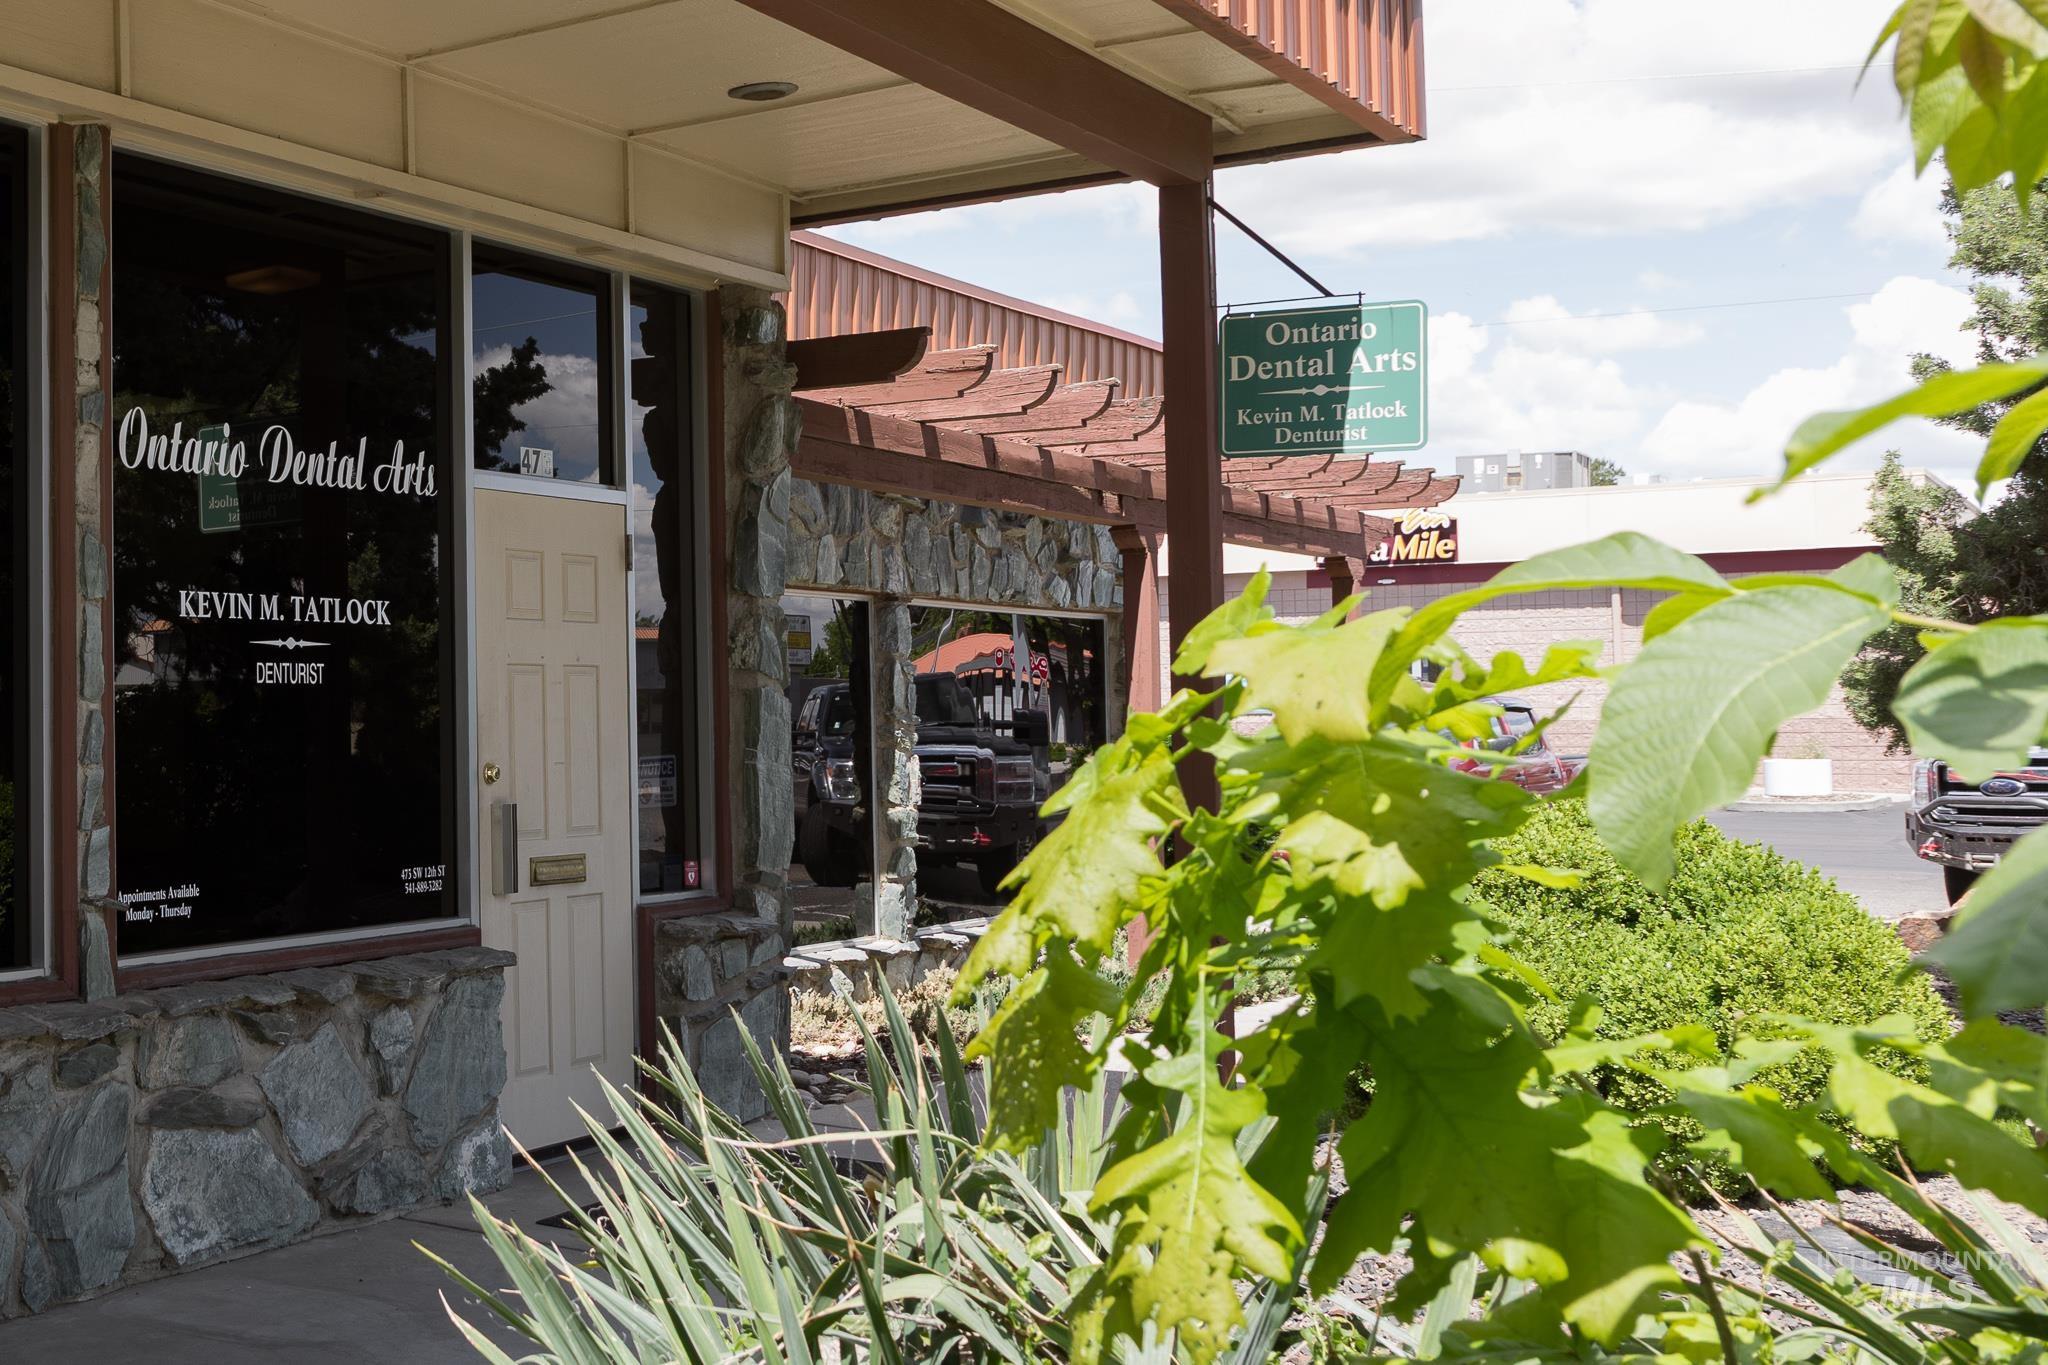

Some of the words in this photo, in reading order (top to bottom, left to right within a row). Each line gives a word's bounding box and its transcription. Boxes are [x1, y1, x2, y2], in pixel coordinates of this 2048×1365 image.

[1265, 316, 1377, 346] Ontario
[1229, 348, 1336, 382] Dental
[1346, 347, 1417, 374] Arts
[1237, 407, 1293, 426] Kevin
[1300, 405, 1325, 422] M.
[1332, 400, 1408, 421] Tatlock
[1275, 425, 1369, 444] Denturist
[118, 406, 249, 478] Ontario
[259, 425, 367, 490] Dental
[373, 439, 438, 497] Arts
[179, 590, 253, 619] KEVIN
[260, 594, 285, 621] M.
[291, 596, 391, 625] TATLOCK
[256, 662, 325, 684] DENTURIST
[640, 760, 673, 777] NOTICE
[413, 867, 423, 879] SW
[424, 865, 437, 878] 12th
[438, 865, 446, 876] ST
[117, 889, 166, 904] Appointments
[168, 883, 200, 899] Available
[125, 907, 154, 922] Monday
[160, 903, 192, 918] Thursday
